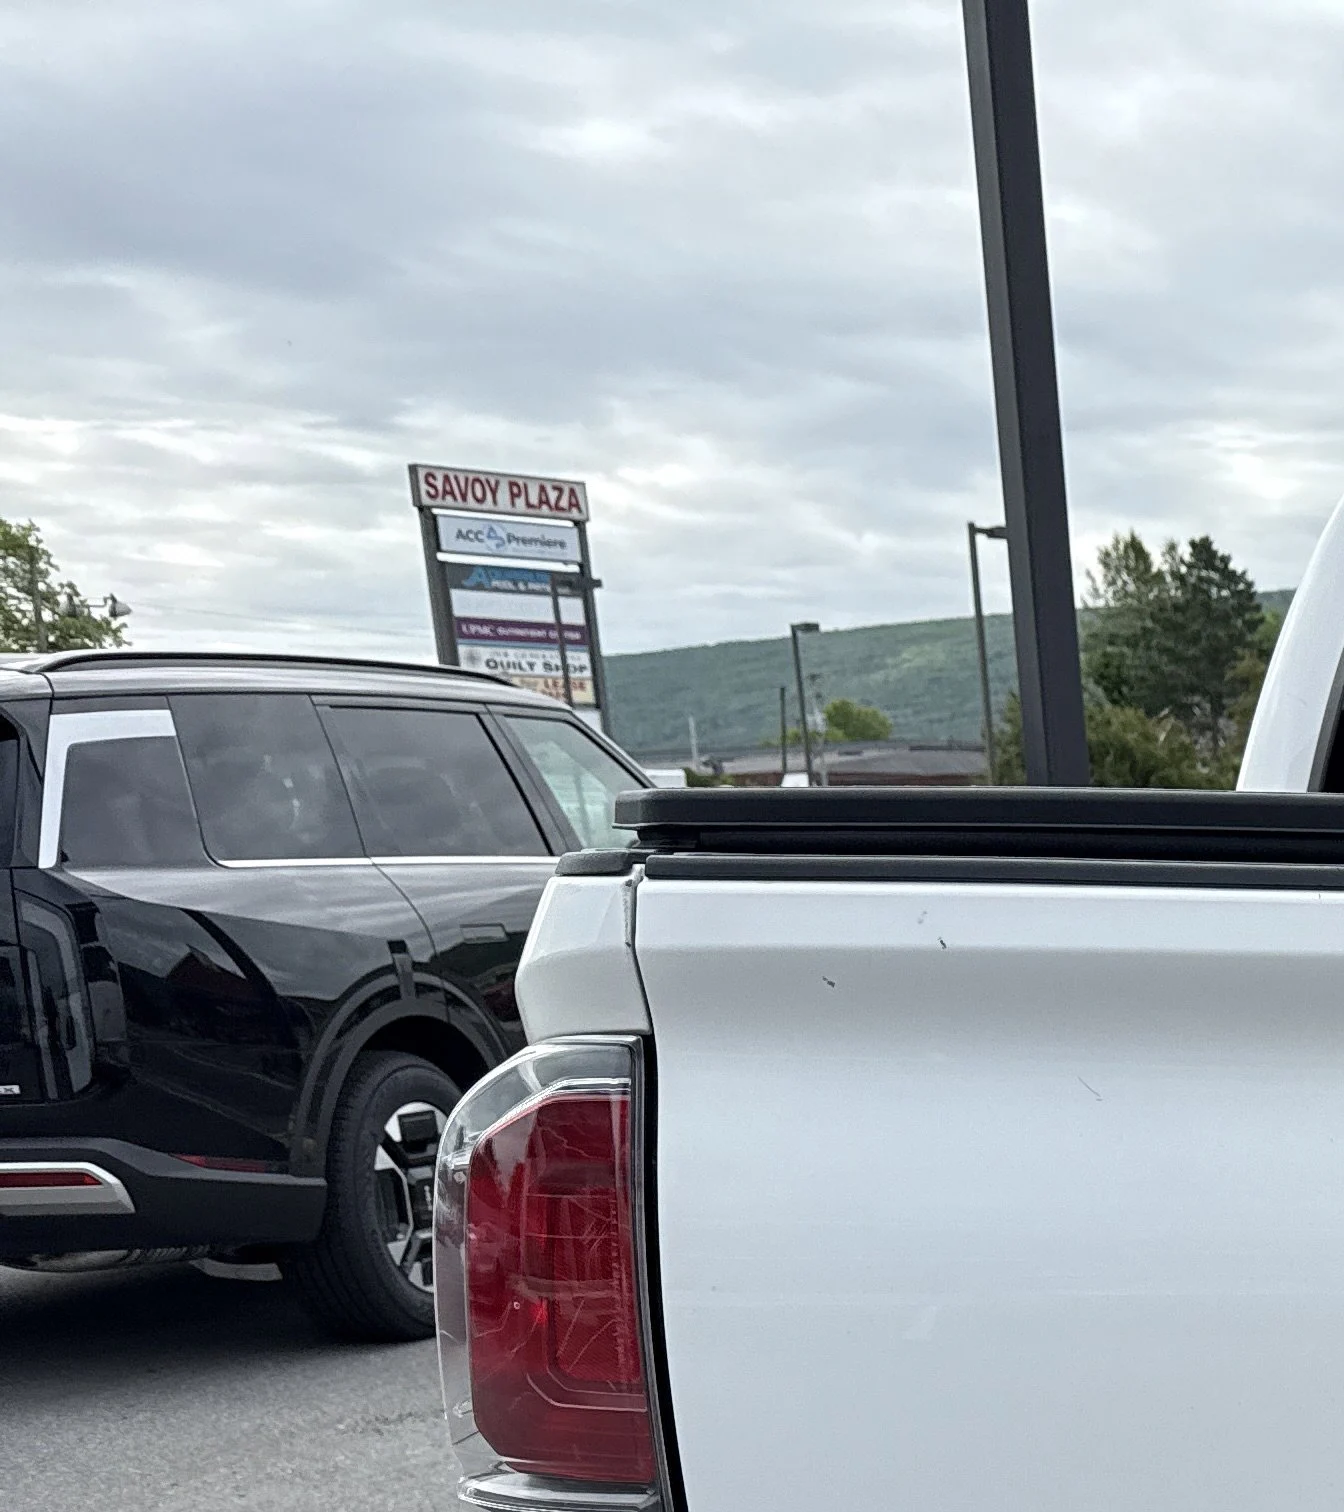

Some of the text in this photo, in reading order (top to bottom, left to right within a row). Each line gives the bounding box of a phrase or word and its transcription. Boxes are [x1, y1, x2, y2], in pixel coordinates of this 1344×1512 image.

[424, 471, 583, 514] SAVOY PLAZA
[455, 528, 567, 549] ACC Premiere
[485, 658, 537, 672] QUILT
